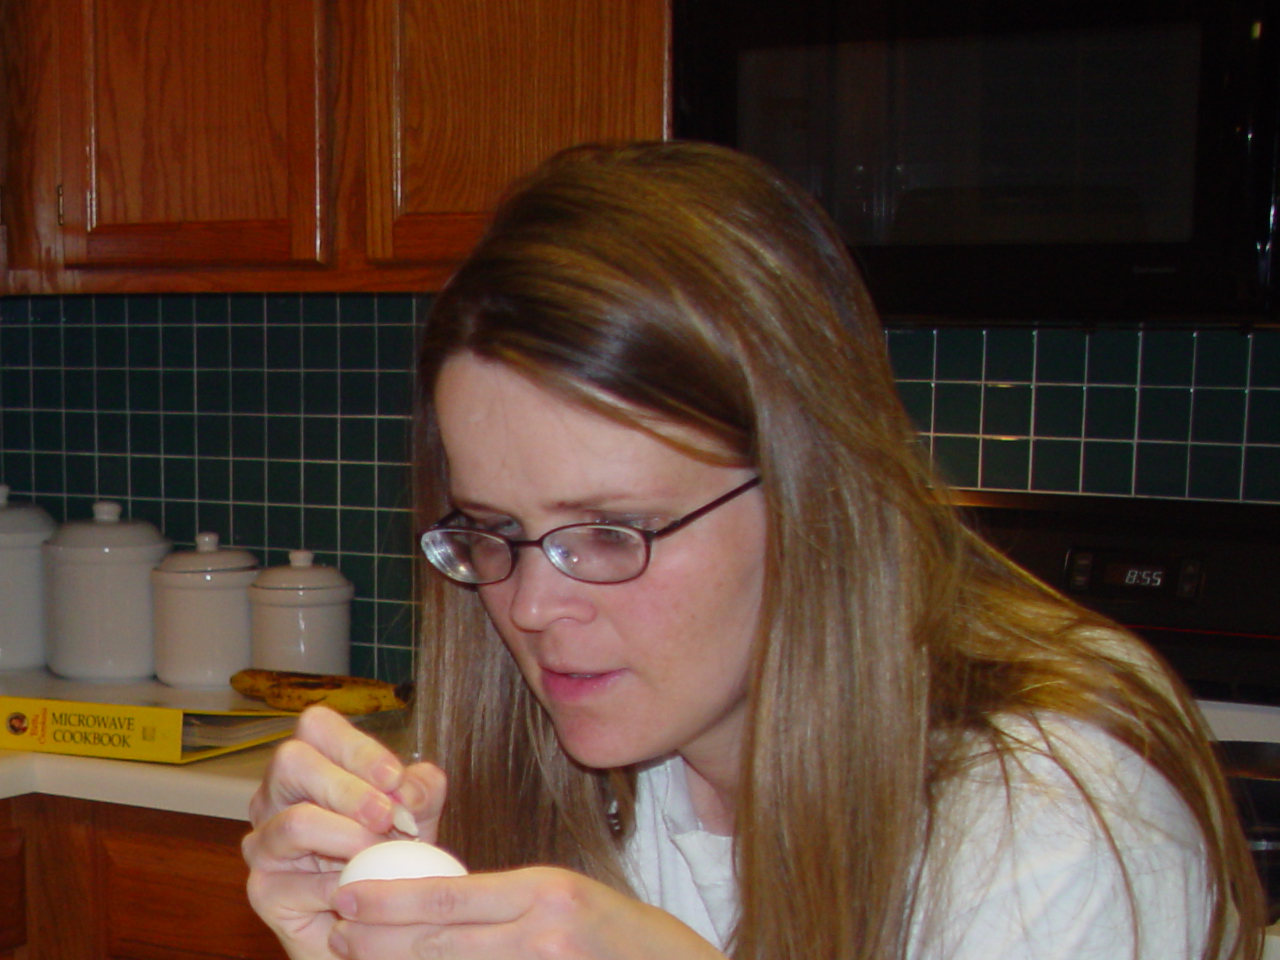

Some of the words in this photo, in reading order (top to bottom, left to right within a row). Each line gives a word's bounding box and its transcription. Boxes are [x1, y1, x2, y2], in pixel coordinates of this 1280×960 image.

[1125, 569, 1163, 587] 8:55
[51, 712, 135, 732] MICROWAVE
[53, 729, 131, 748] COOKBOOK
